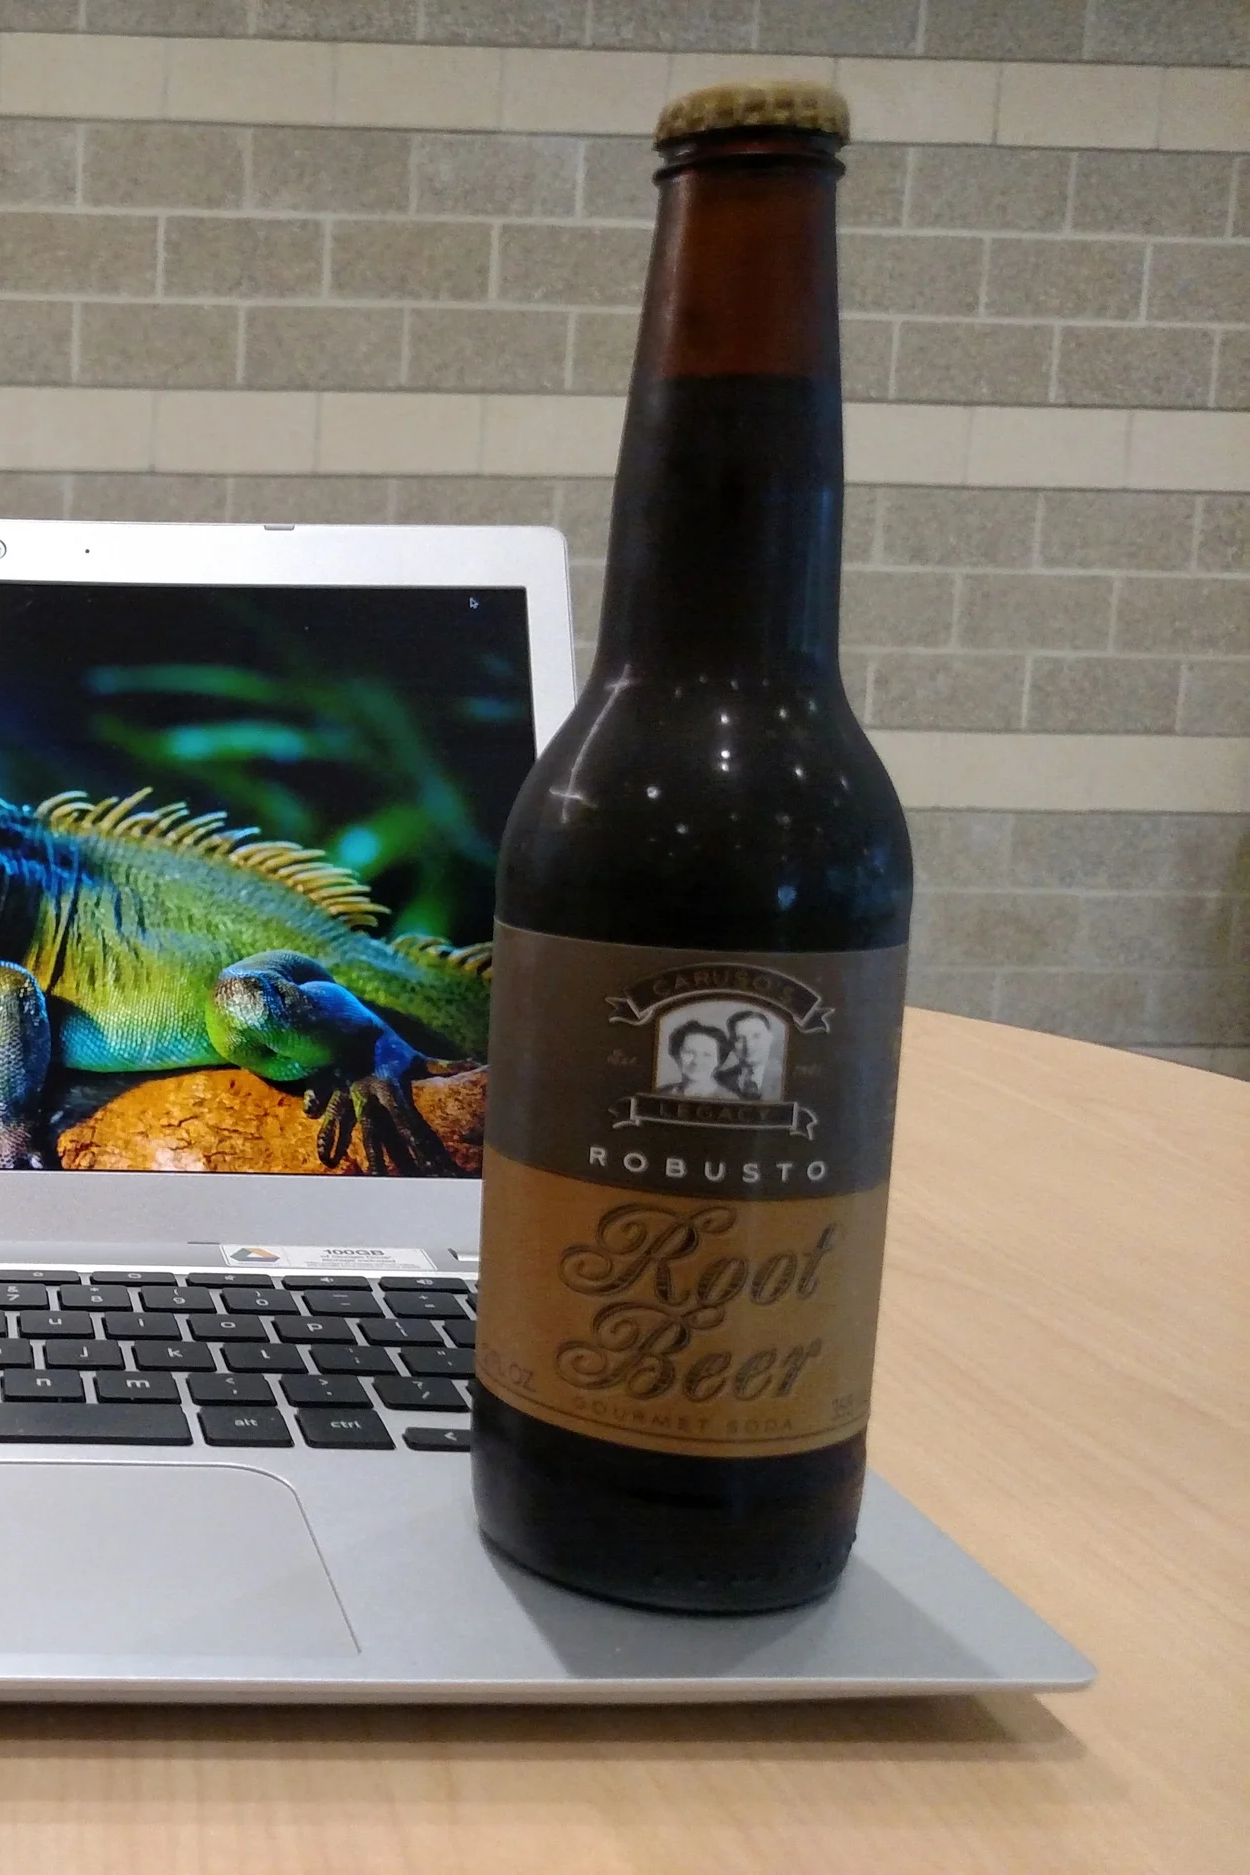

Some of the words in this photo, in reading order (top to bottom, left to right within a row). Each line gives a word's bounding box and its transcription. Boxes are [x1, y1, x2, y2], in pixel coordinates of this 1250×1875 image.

[588, 1146, 829, 1183] ROBUSTO
[558, 1202, 838, 1306] Root
[306, 1322, 323, 1332] p
[167, 1347, 183, 1358] k
[556, 1301, 823, 1402] Beer
[35, 1377, 52, 1387] n
[126, 1379, 151, 1388] m
[234, 1418, 258, 1427] alt
[330, 1420, 362, 1429] ctrl
